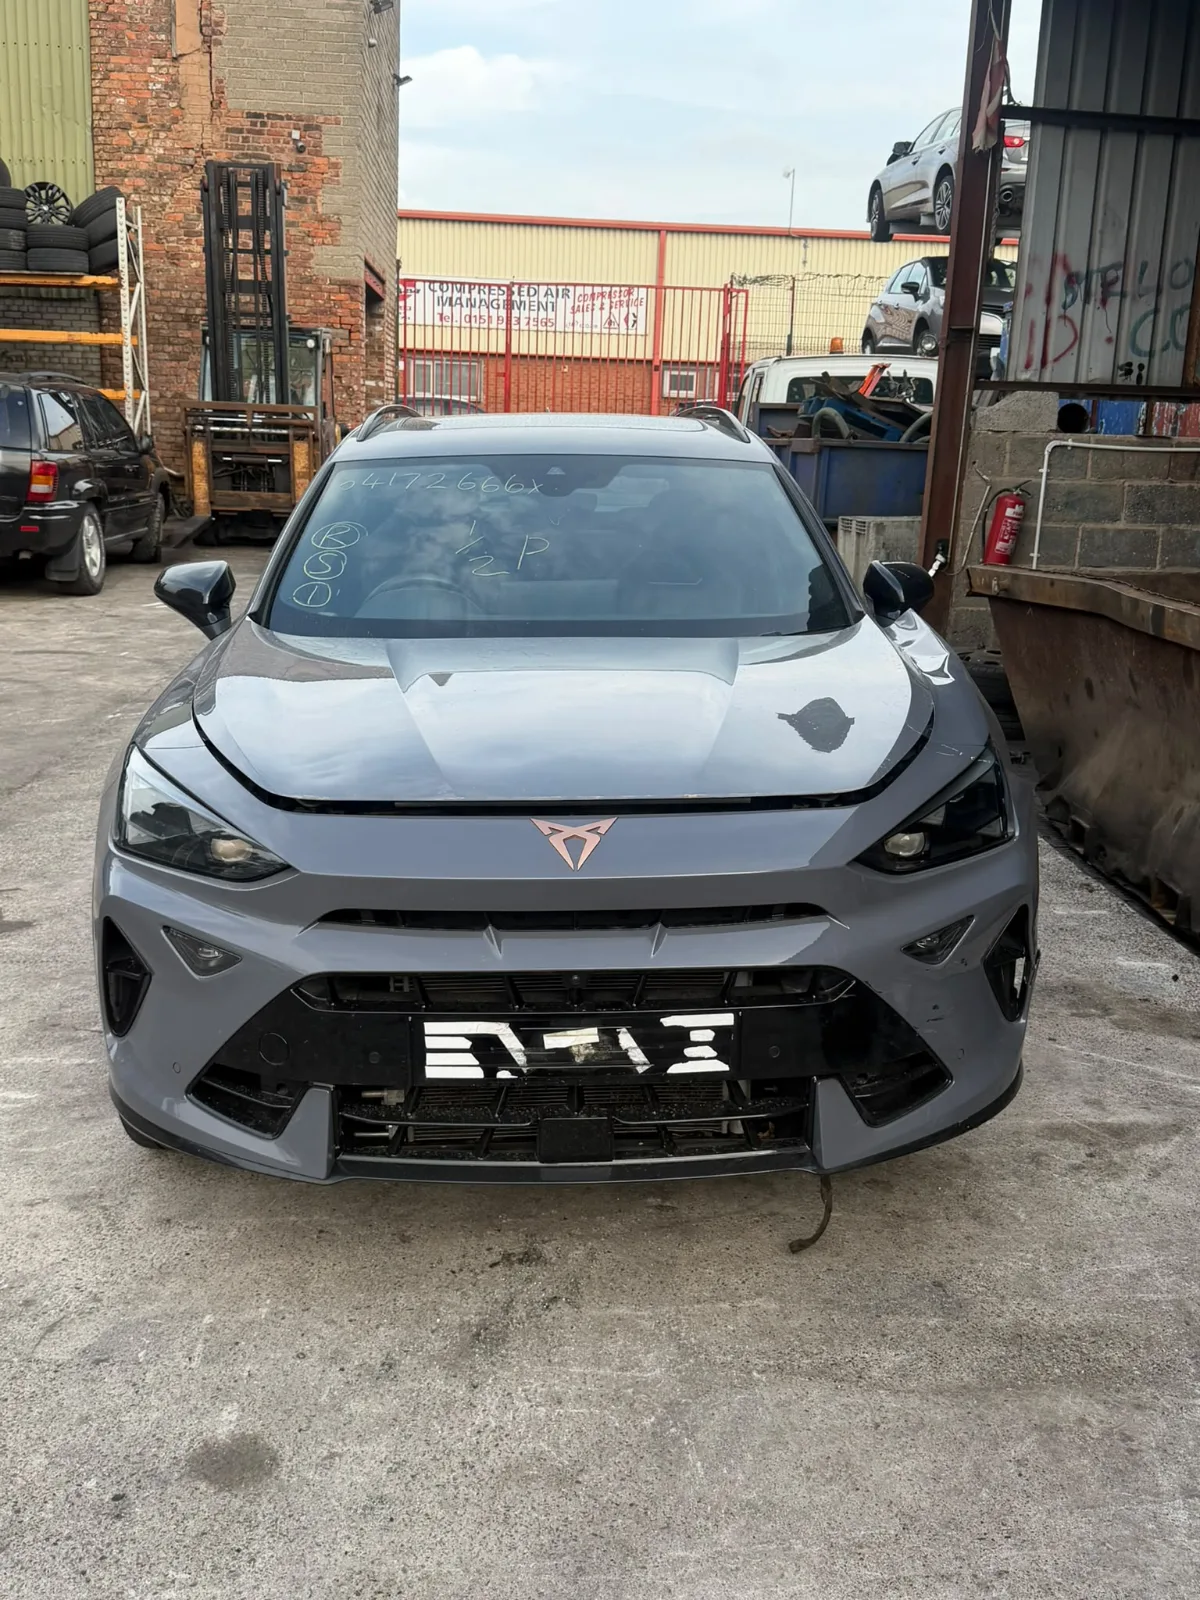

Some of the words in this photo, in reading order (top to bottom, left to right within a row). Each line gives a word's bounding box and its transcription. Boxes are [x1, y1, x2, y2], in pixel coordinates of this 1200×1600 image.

[543, 287, 571, 299] AIR
[577, 288, 635, 303] COMPRESSOR
[570, 303, 595, 315] SALES
[610, 297, 644, 310] SERVICE
[437, 313, 458, 323] Te.
[497, 315, 520, 326] 93
[524, 316, 555, 328] 7565
[517, 534, 550, 570] P
[307, 552, 341, 576] S
